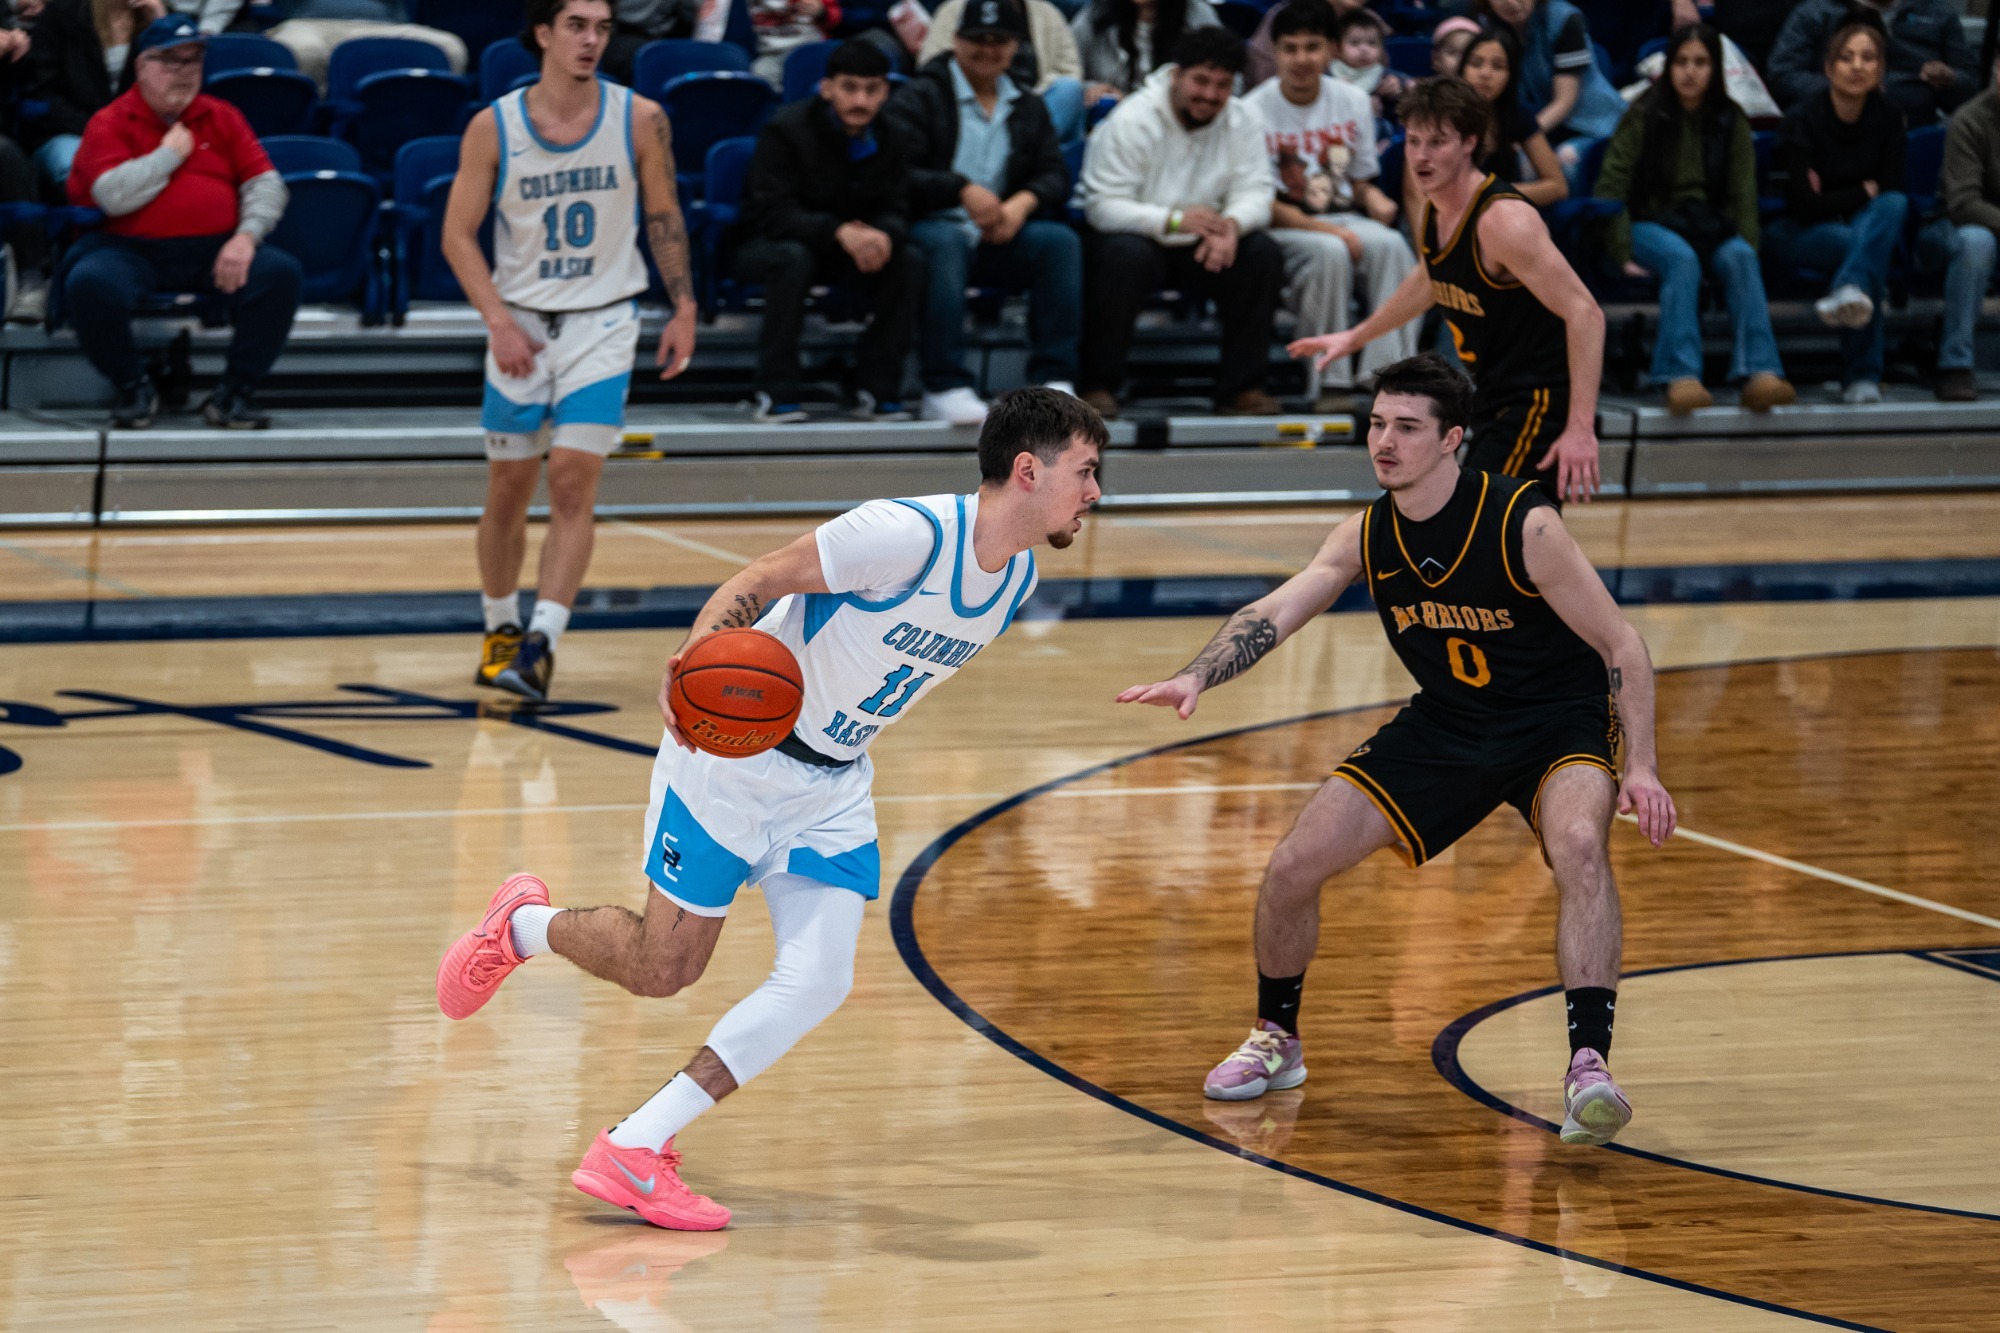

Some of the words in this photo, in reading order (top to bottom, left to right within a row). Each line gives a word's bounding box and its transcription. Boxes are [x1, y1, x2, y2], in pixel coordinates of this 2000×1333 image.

[519, 165, 618, 200] COLUMBIA
[543, 201, 595, 251] 10
[539, 257, 595, 279] BASIN
[1446, 636, 1491, 688] 0
[721, 685, 764, 701] NWAC
[857, 663, 935, 718] 11
[691, 717, 778, 747] Baden
